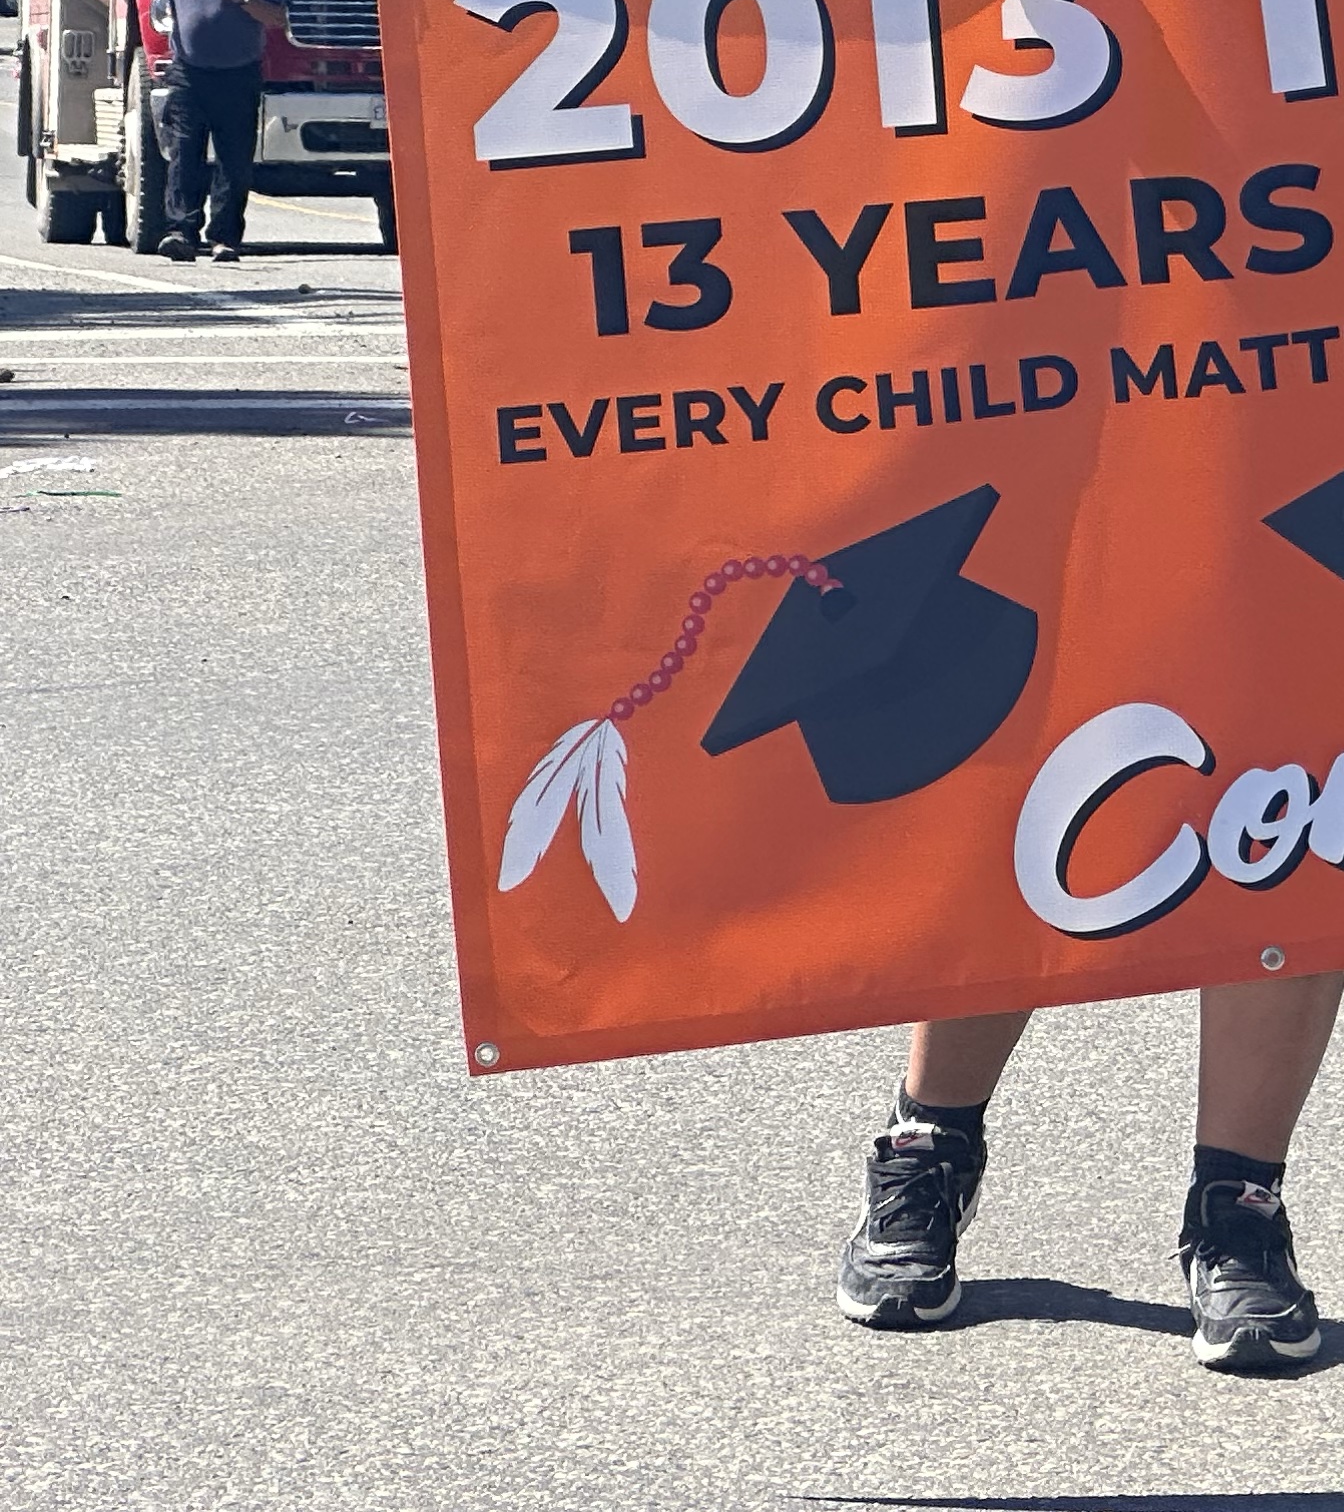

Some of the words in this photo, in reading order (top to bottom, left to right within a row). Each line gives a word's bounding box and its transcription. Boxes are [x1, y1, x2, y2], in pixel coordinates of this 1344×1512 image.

[568, 218, 734, 336] 13
[782, 164, 1335, 316] YEARS
[496, 382, 786, 464] EVERY
[815, 354, 1079, 435] CHILD
